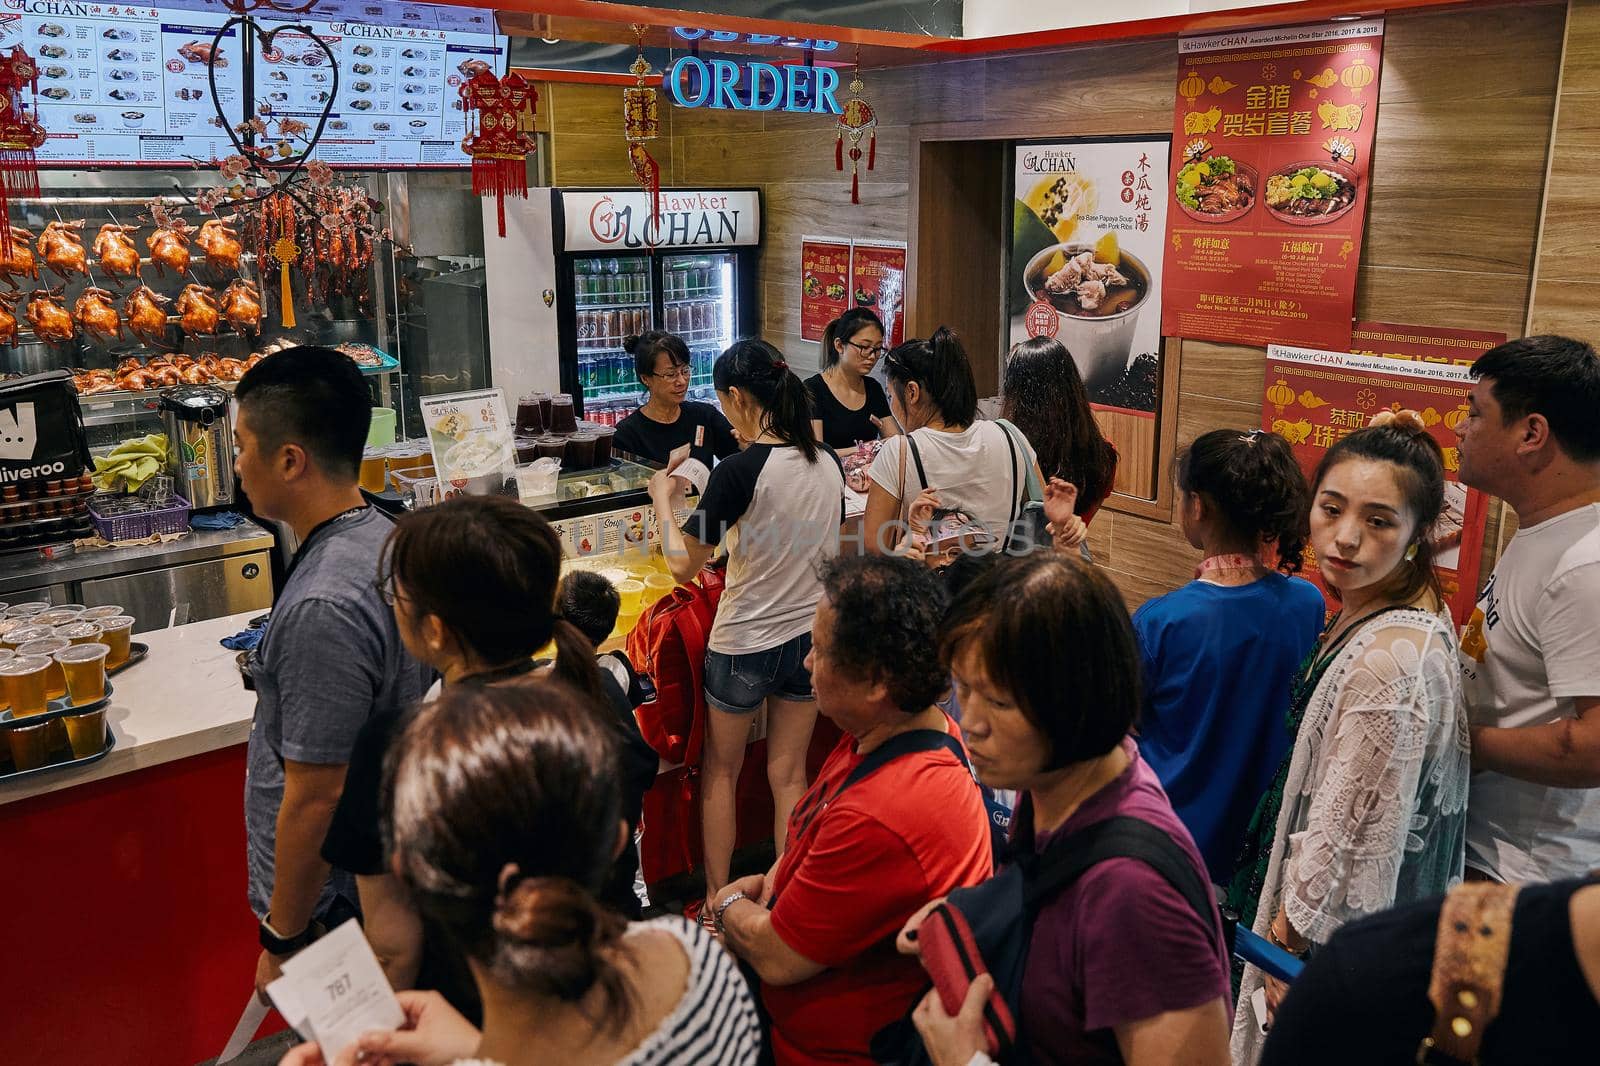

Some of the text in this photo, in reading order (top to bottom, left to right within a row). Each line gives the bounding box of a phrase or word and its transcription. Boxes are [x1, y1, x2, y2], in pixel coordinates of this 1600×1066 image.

[32, 2, 88, 17] CHAN
[351, 25, 393, 39] CHAN
[1250, 35, 1274, 44] Awarded
[1274, 33, 1298, 42] Michelin
[1341, 28, 1356, 36] 2017
[1363, 26, 1378, 34] 2018
[671, 55, 844, 114] ORDER
[1246, 84, 1291, 110] 金猪
[1223, 110, 1313, 137] 贺岁套餐
[1044, 150, 1072, 158] Hawker
[1040, 157, 1076, 172] CHAN
[656, 192, 728, 212] Hawker
[643, 210, 739, 245] CHAN
[1099, 215, 1118, 223] Papaya
[1119, 215, 1134, 223] Soup
[1345, 359, 1372, 369] Awarded
[1373, 362, 1398, 372] Michelin
[1399, 365, 1412, 374] One
[1413, 366, 1426, 375] Star
[1427, 369, 1444, 378] 2016,
[1446, 371, 1462, 379] 2017
[1462, 372, 1469, 380] &
